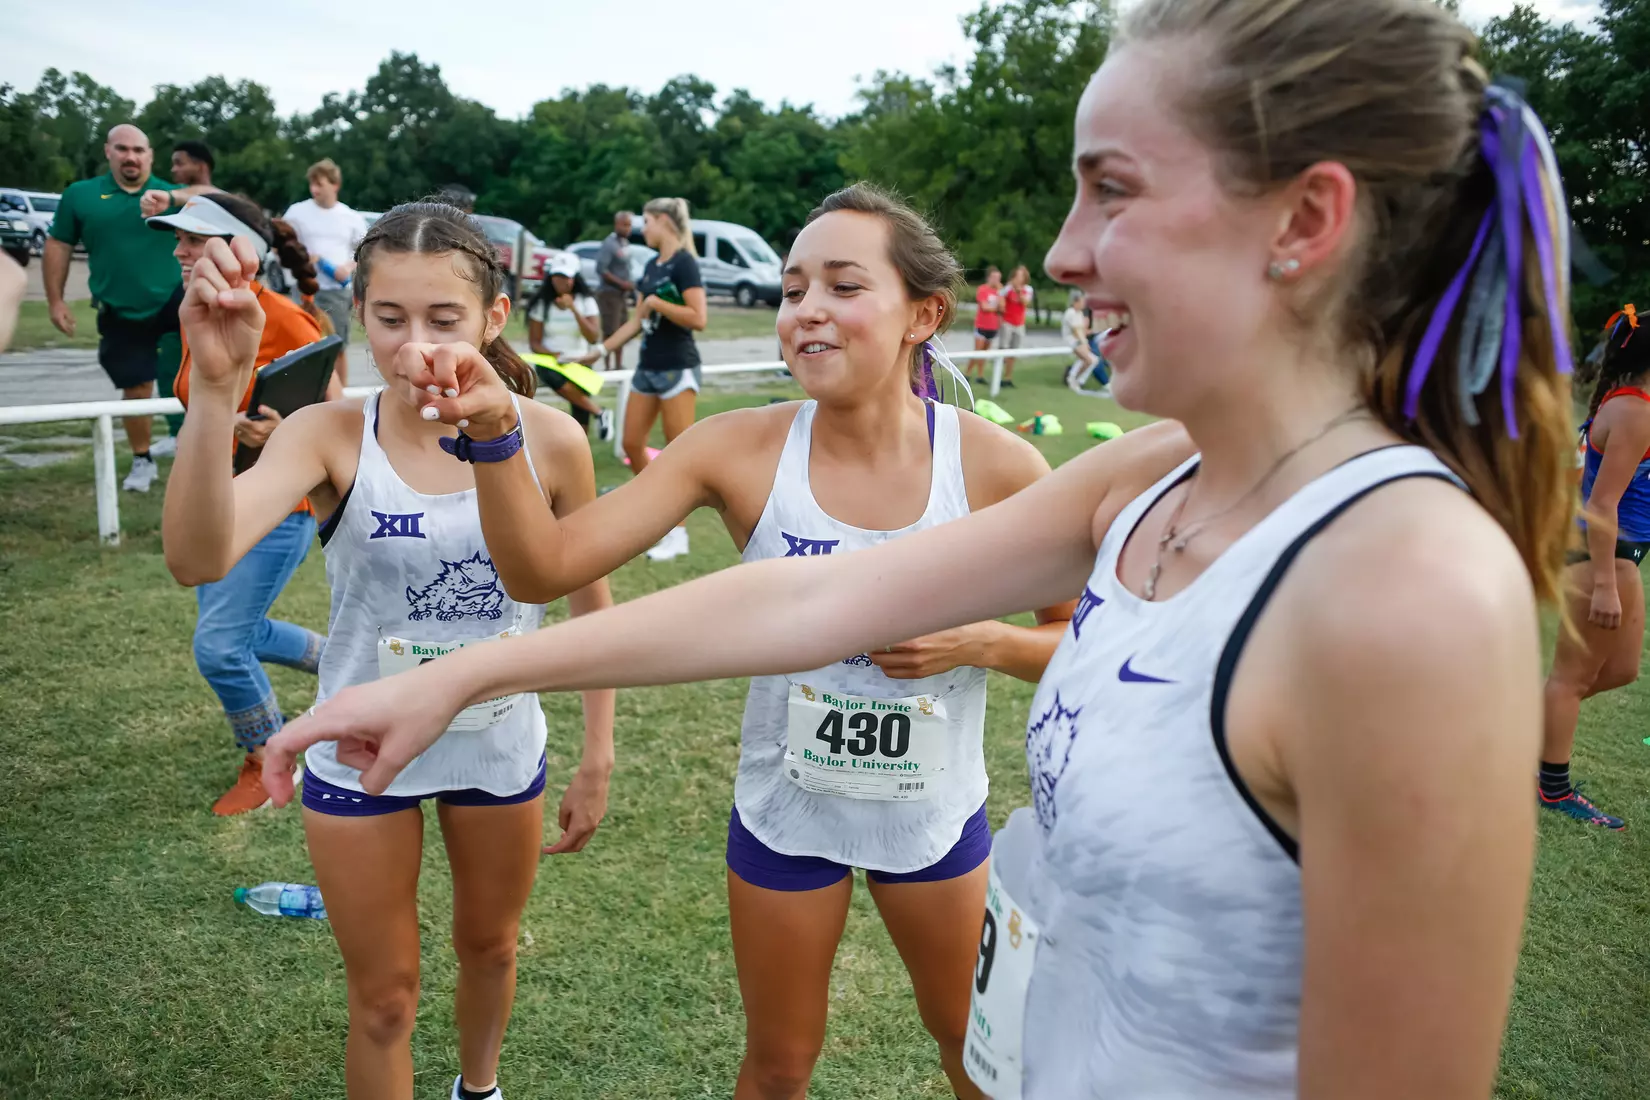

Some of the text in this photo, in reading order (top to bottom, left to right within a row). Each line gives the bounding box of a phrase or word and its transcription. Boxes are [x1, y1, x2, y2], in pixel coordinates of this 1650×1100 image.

[370, 510, 426, 539] XII
[822, 694, 866, 711] Baylor
[871, 701, 912, 712] Invite
[816, 709, 911, 758] 430
[803, 748, 847, 767] Baylor
[852, 758, 921, 773] University
